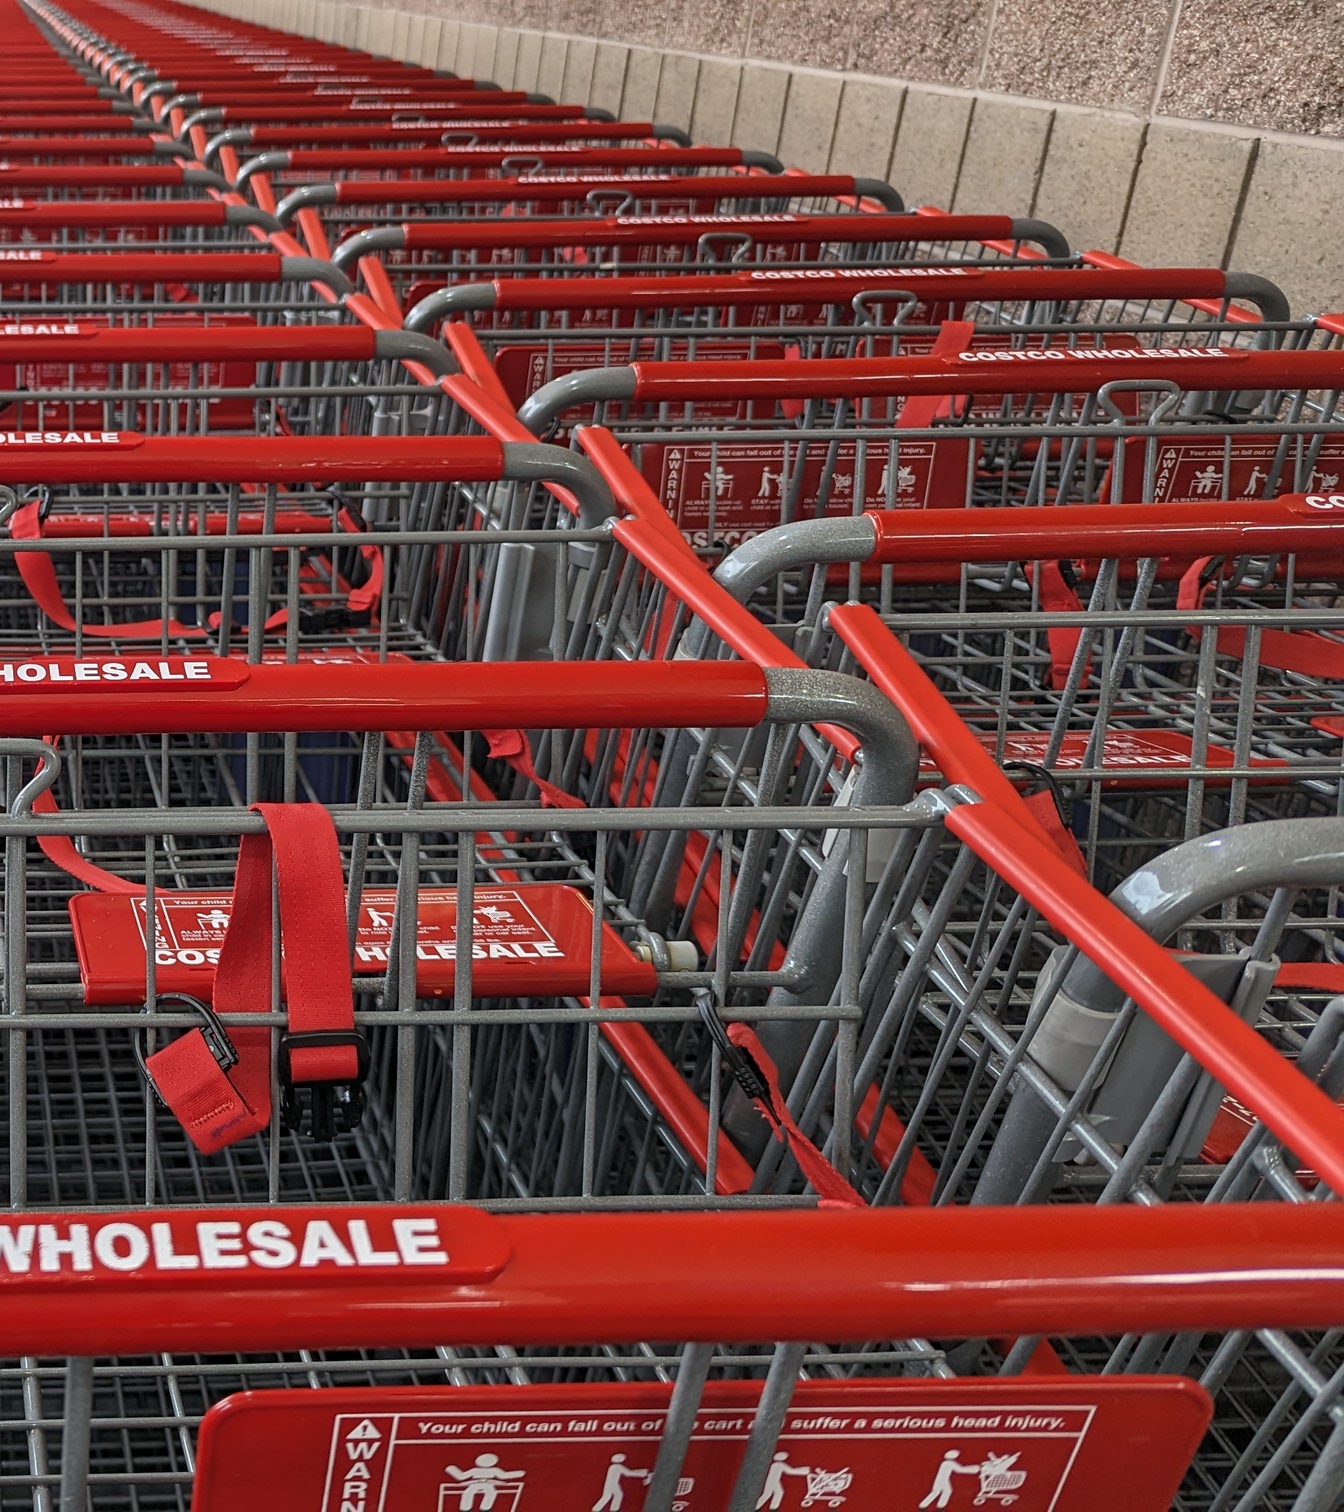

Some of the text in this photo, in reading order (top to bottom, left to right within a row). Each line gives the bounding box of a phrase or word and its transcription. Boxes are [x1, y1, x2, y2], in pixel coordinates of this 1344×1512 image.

[617, 214, 795, 225] COSTCO WHOLESALE
[751, 268, 967, 280] COSTCO WHOLESALE
[958, 348, 1229, 362] COSTCO WHOLESALE
[666, 460, 681, 518] WARNIN
[355, 942, 565, 962] HLESALE
[417, 1421, 467, 1435] Your
[470, 1420, 522, 1434] child
[525, 1421, 563, 1433] can
[567, 1419, 598, 1433] fall
[603, 1420, 637, 1432] out
[641, 1418, 663, 1432] of
[703, 1418, 744, 1431] cart
[790, 1415, 850, 1430] suffer
[853, 1418, 866, 1430] a
[871, 1416, 945, 1430] serious
[951, 1415, 1000, 1429] head
[1004, 1414, 1065, 1432] injury.
